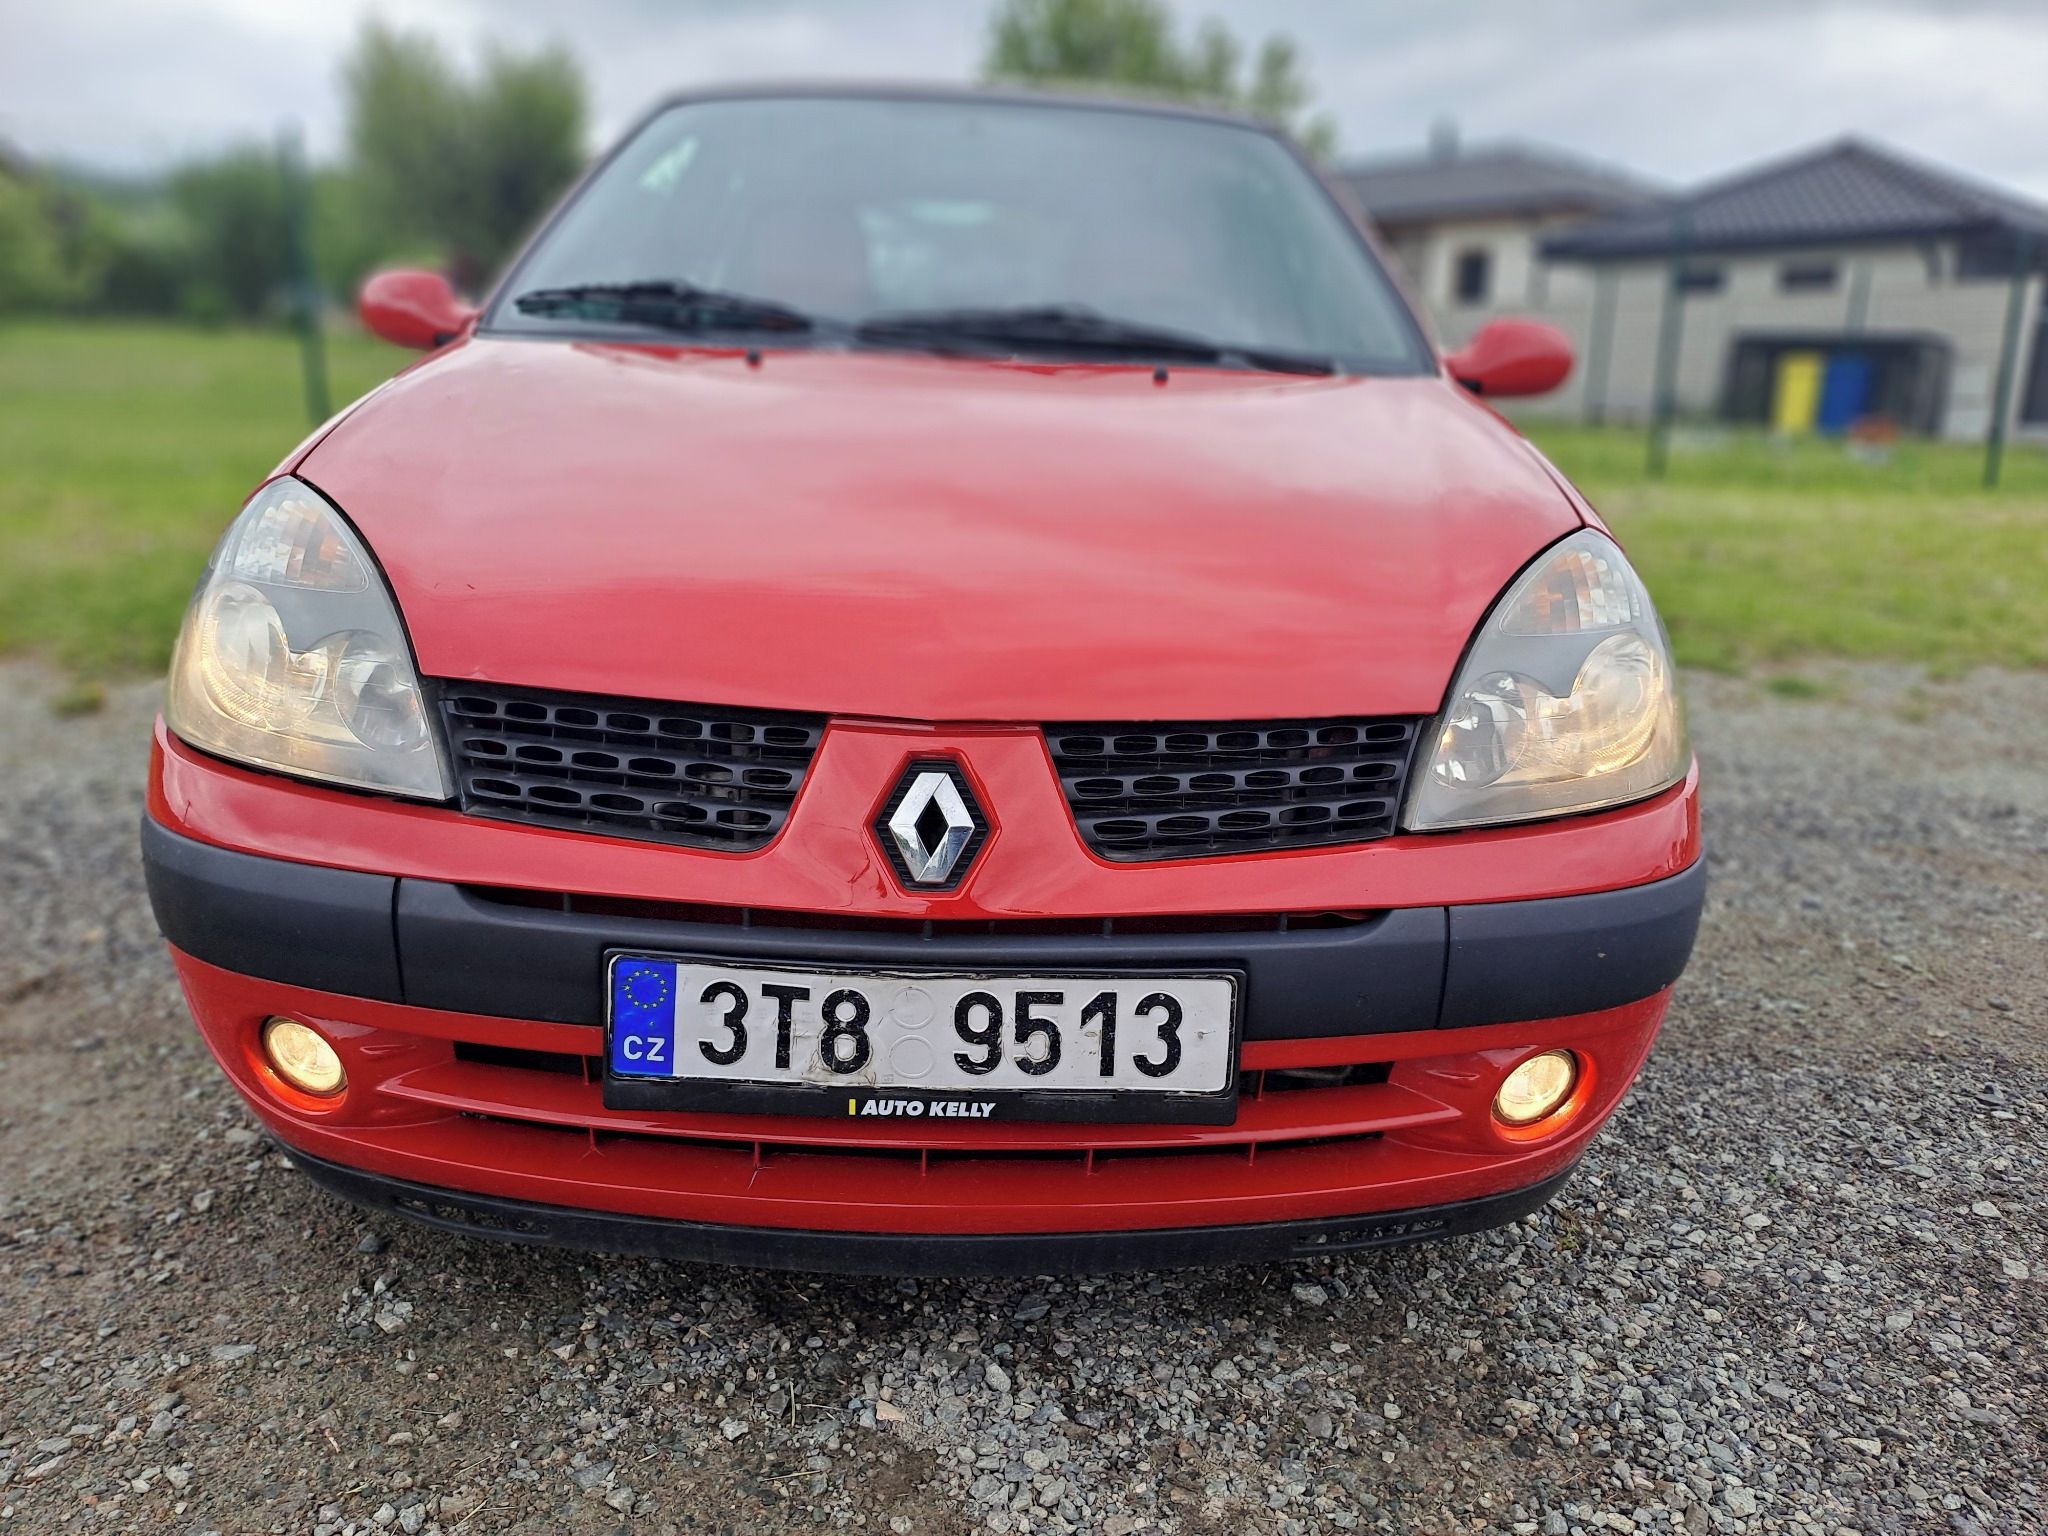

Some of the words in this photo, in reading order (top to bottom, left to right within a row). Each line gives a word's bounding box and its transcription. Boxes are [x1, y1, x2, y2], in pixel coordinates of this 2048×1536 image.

[698, 980, 872, 1075] 3T8
[952, 990, 1184, 1077] 9513
[622, 1034, 665, 1062] CZ
[861, 1100, 924, 1116] AUTO
[929, 1102, 996, 1117] KELLY
